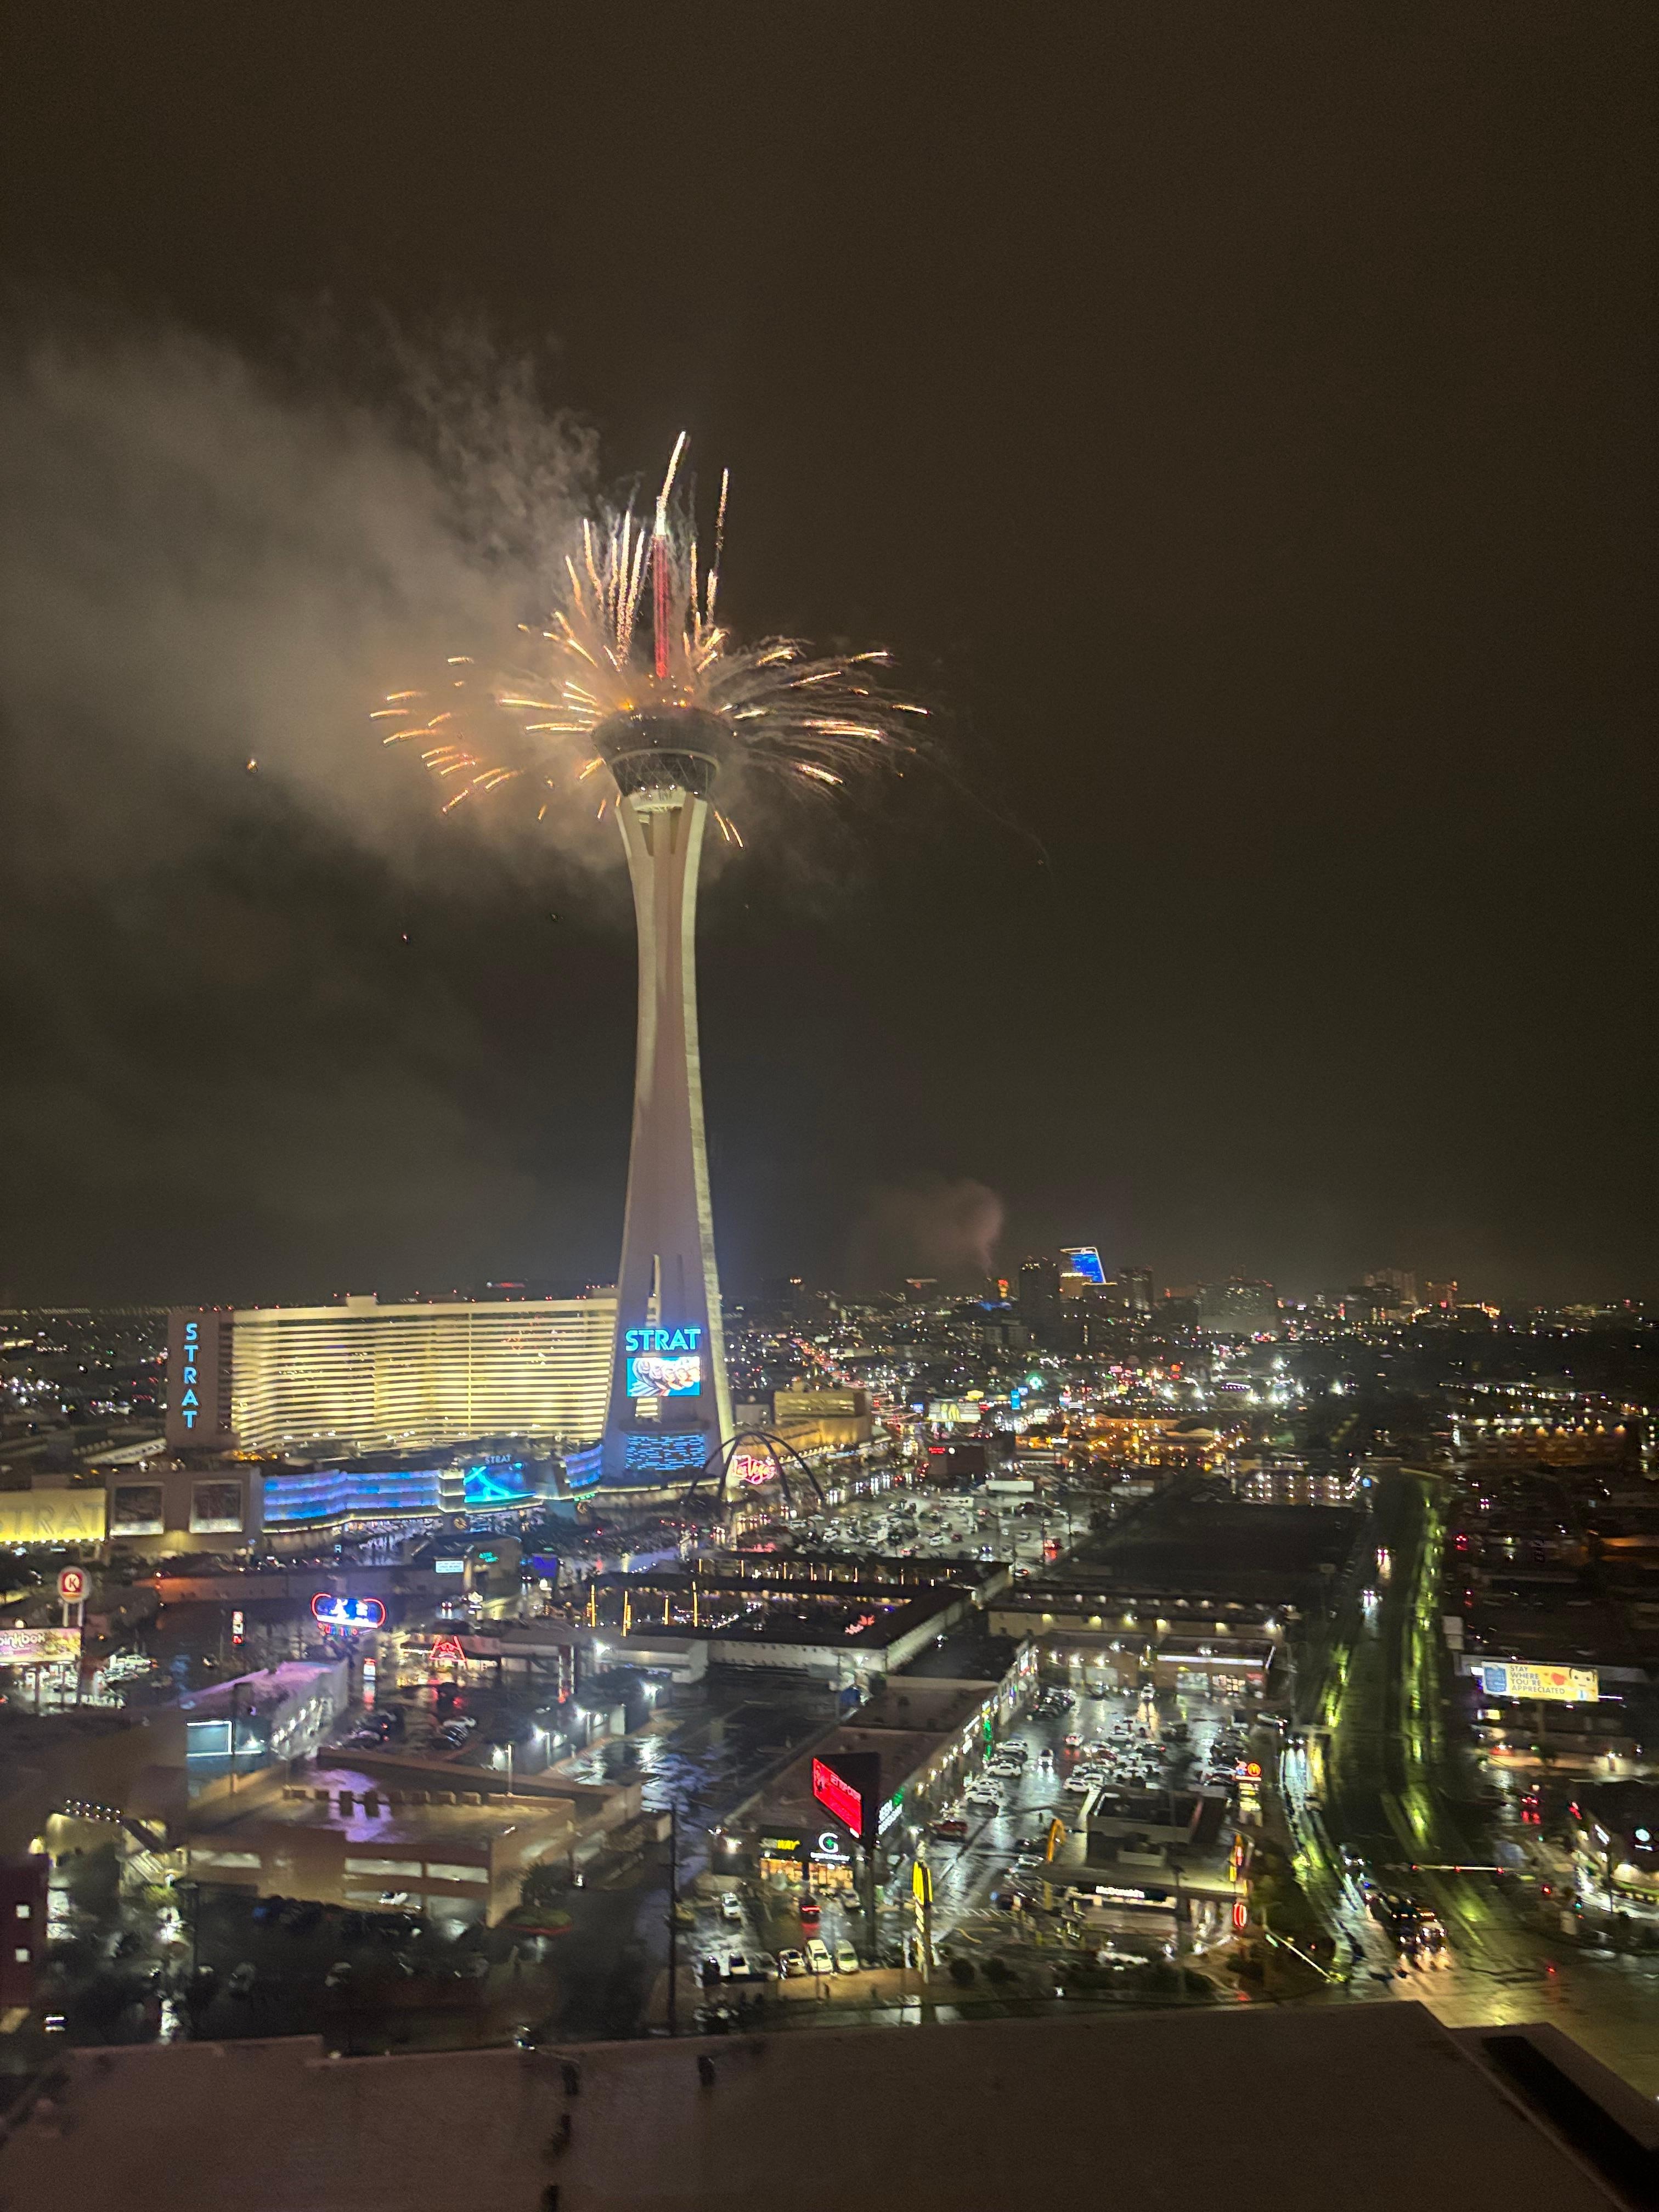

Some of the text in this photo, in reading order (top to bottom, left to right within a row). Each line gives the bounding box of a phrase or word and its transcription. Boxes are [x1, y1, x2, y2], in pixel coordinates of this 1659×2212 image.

[625, 1328, 701, 1351] STRAT
[182, 1323, 199, 1429] STRAT
[485, 1454, 511, 1464] STRAT
[742, 1454, 776, 1485] Vegas
[0, 1502, 105, 1535] TRAT
[1511, 1685, 1565, 1694] APPRECIATED
